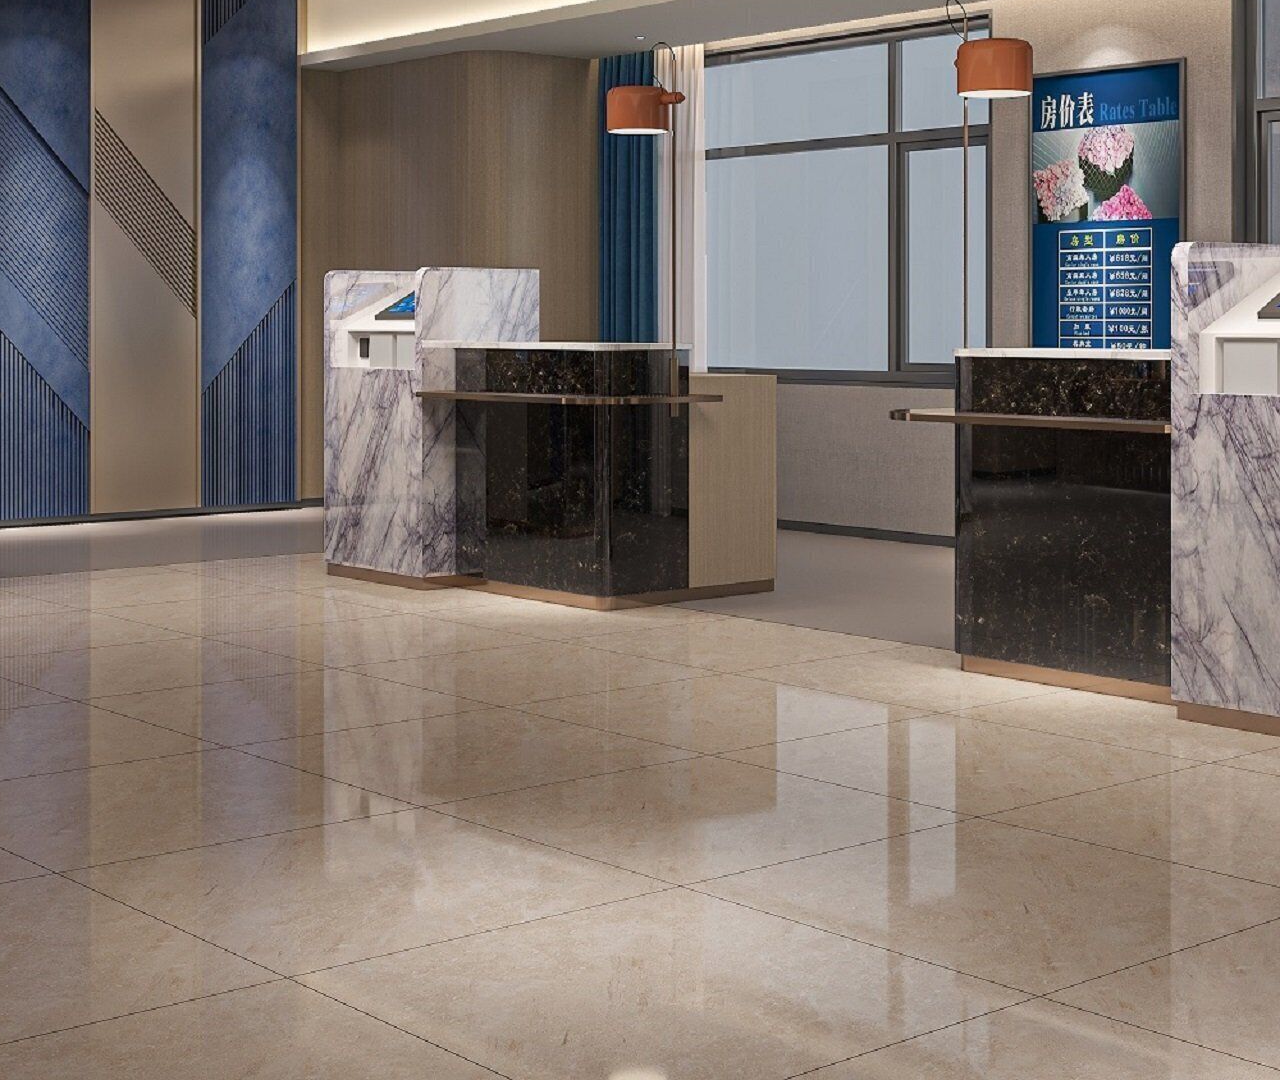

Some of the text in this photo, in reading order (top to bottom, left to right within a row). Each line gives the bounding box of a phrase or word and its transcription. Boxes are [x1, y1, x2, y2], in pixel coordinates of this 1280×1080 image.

[1040, 92, 1094, 129] 房价表
[1100, 96, 1177, 121] Rates Table
